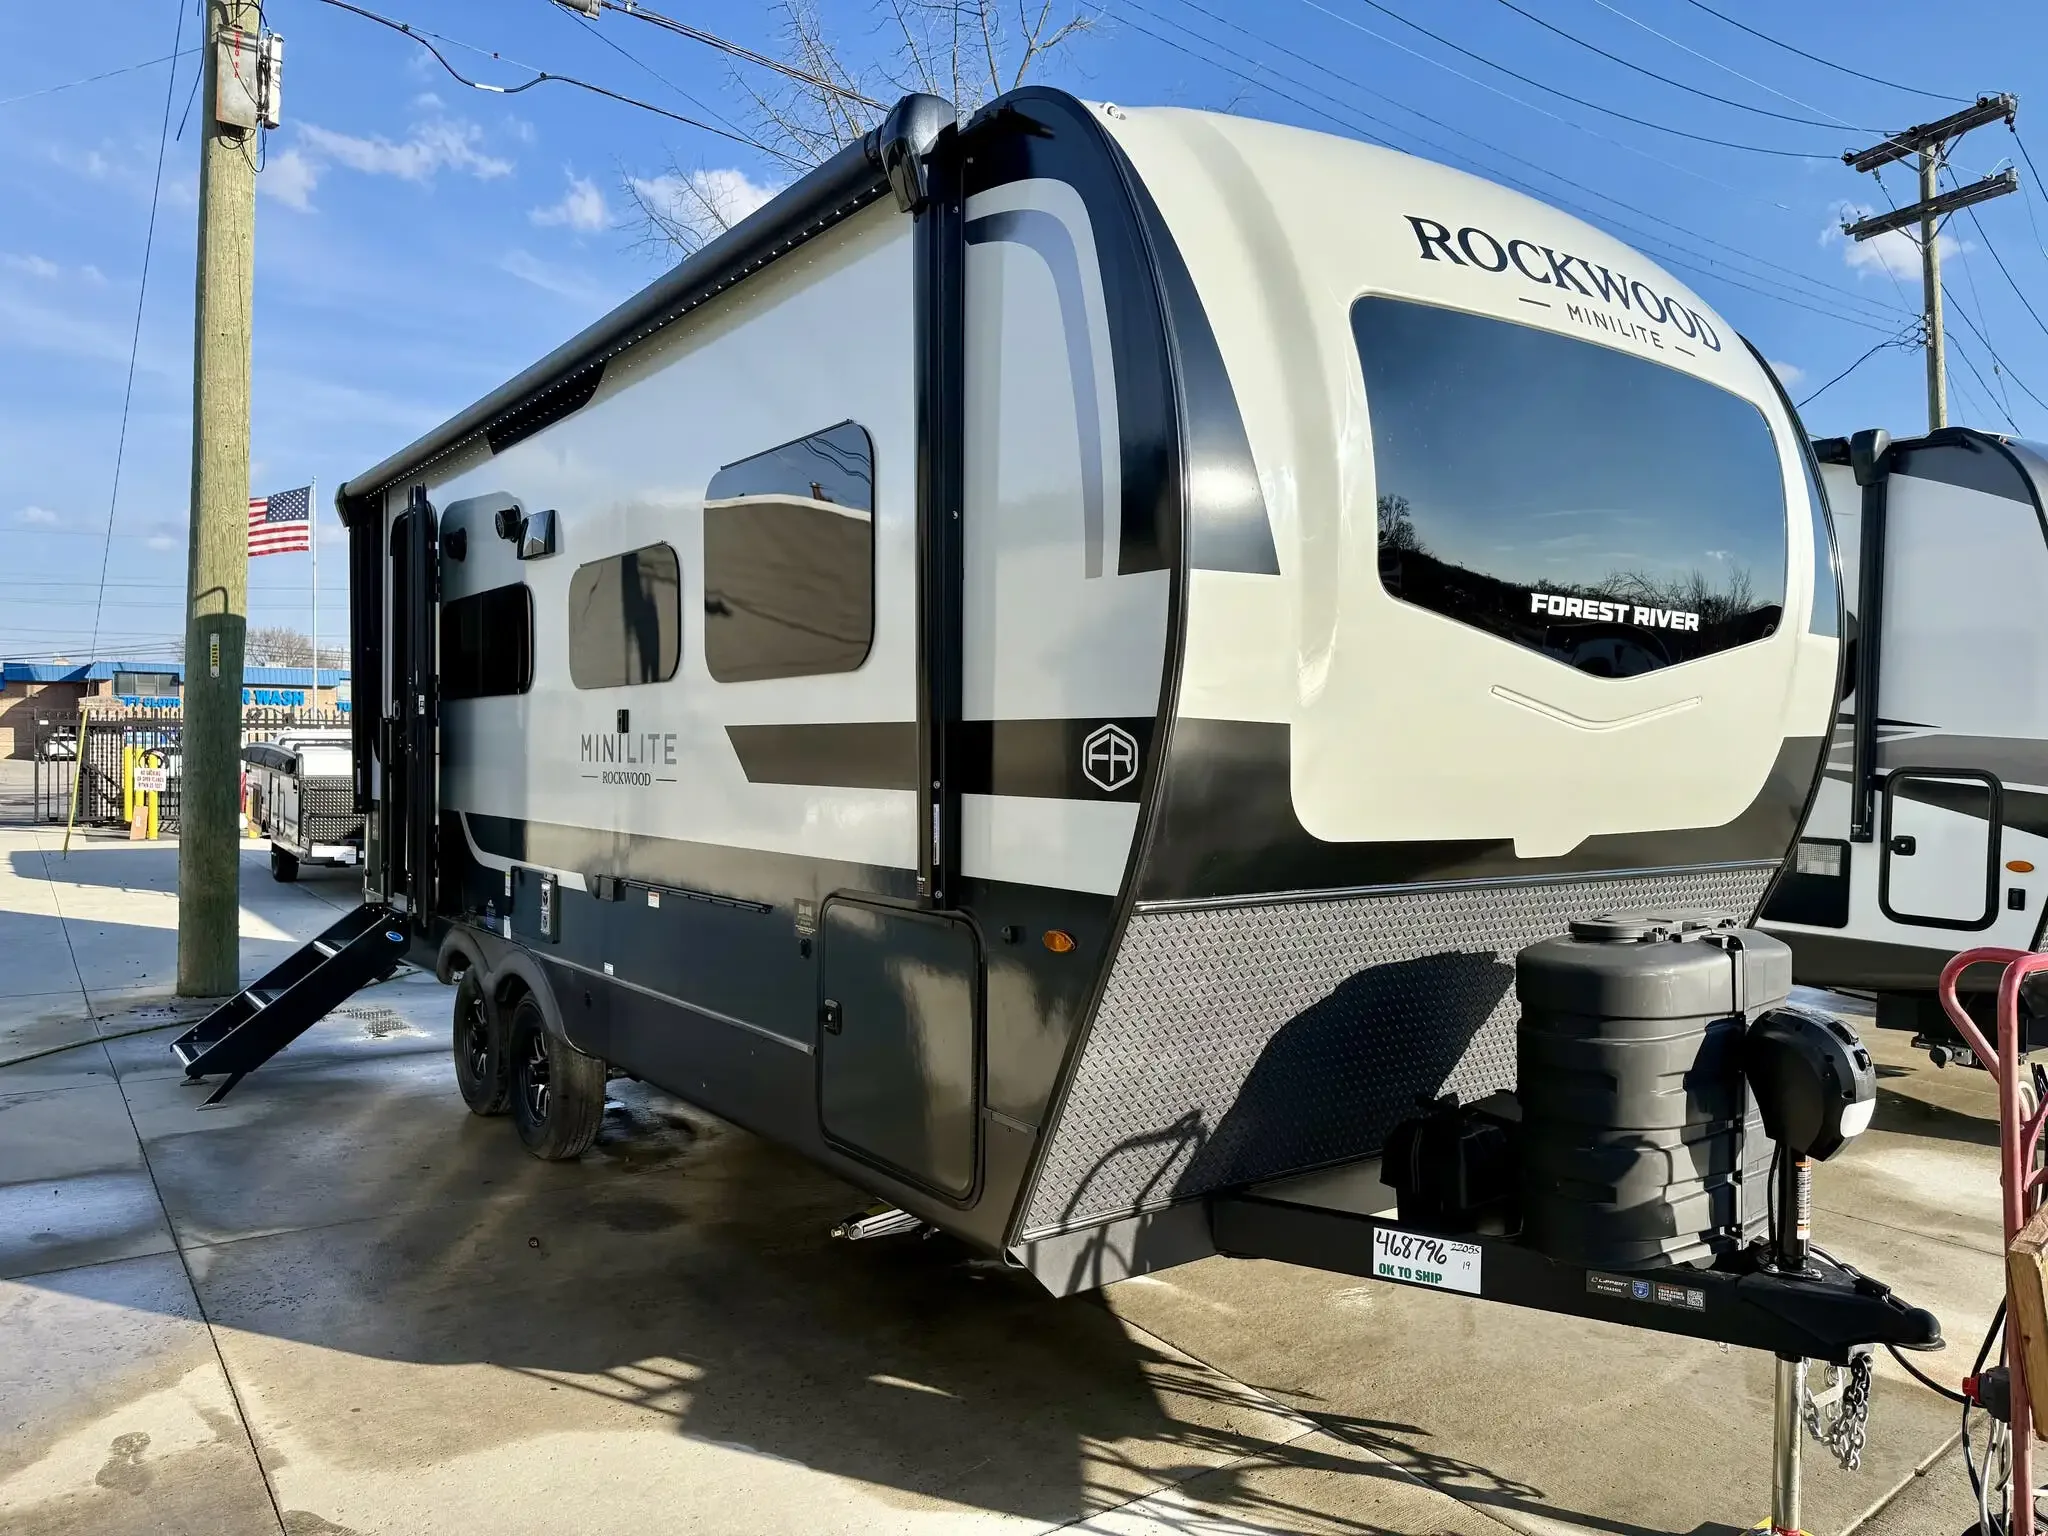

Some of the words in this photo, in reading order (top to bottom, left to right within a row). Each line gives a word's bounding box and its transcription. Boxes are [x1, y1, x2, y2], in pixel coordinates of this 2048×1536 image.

[1403, 215, 1721, 353] ROCKWOOD
[1567, 303, 1664, 349] MINILITE
[1531, 593, 1630, 623] FOREST
[1633, 605, 1700, 632] RIVER
[255, 689, 305, 706] WASH
[581, 733, 677, 765] MINILITE
[602, 771, 651, 787] ROCKWOOD
[1376, 1230, 1447, 1264] 468796
[1379, 1262, 1395, 1276] OK
[1398, 1266, 1412, 1279] TO
[1415, 1269, 1443, 1284] SHIP
